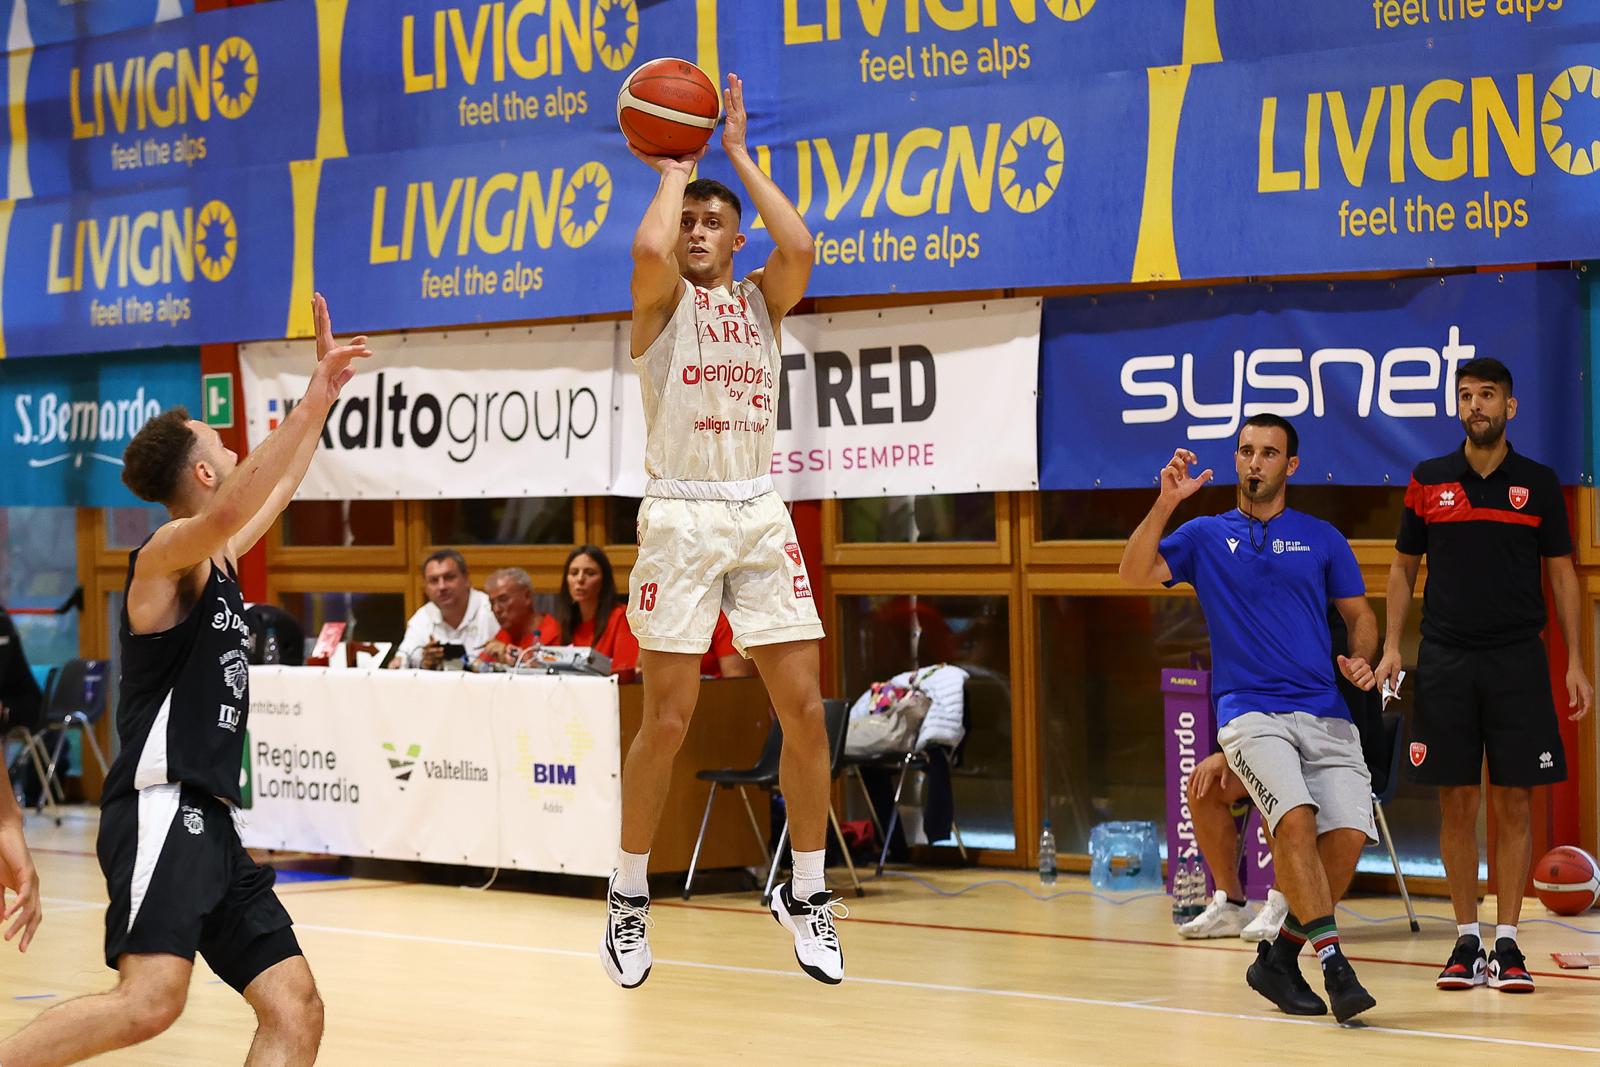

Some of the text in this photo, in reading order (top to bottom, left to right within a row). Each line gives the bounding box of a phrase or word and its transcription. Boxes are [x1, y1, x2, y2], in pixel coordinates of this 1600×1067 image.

[1373, 0, 1430, 30] feel
[1437, 0, 1486, 22] the
[402, 0, 639, 95] LIVIGNO
[860, 38, 1031, 83] feel the alps
[70, 36, 259, 140] LIVIGNO
[458, 85, 588, 126] feel the alps
[1256, 64, 1600, 194] LIVIGNO
[111, 132, 207, 171] feel the alps
[368, 160, 613, 265] LIVIGNO
[1338, 191, 1529, 239] feel the alps
[47, 199, 238, 294] LIVIGNO
[814, 225, 981, 268] feel the alps
[421, 261, 543, 299] feel the alps
[90, 292, 191, 327] feel the alps
[729, 388, 744, 401] by
[1119, 325, 1477, 440] sysnet
[842, 443, 935, 470] SEMPRE
[639, 582, 658, 612] 13
[257, 741, 337, 775] Regione
[423, 760, 489, 782] Valtellina
[533, 763, 577, 785] BIM
[258, 772, 360, 804] Lombardia
[1233, 749, 1279, 816] SPALDING
